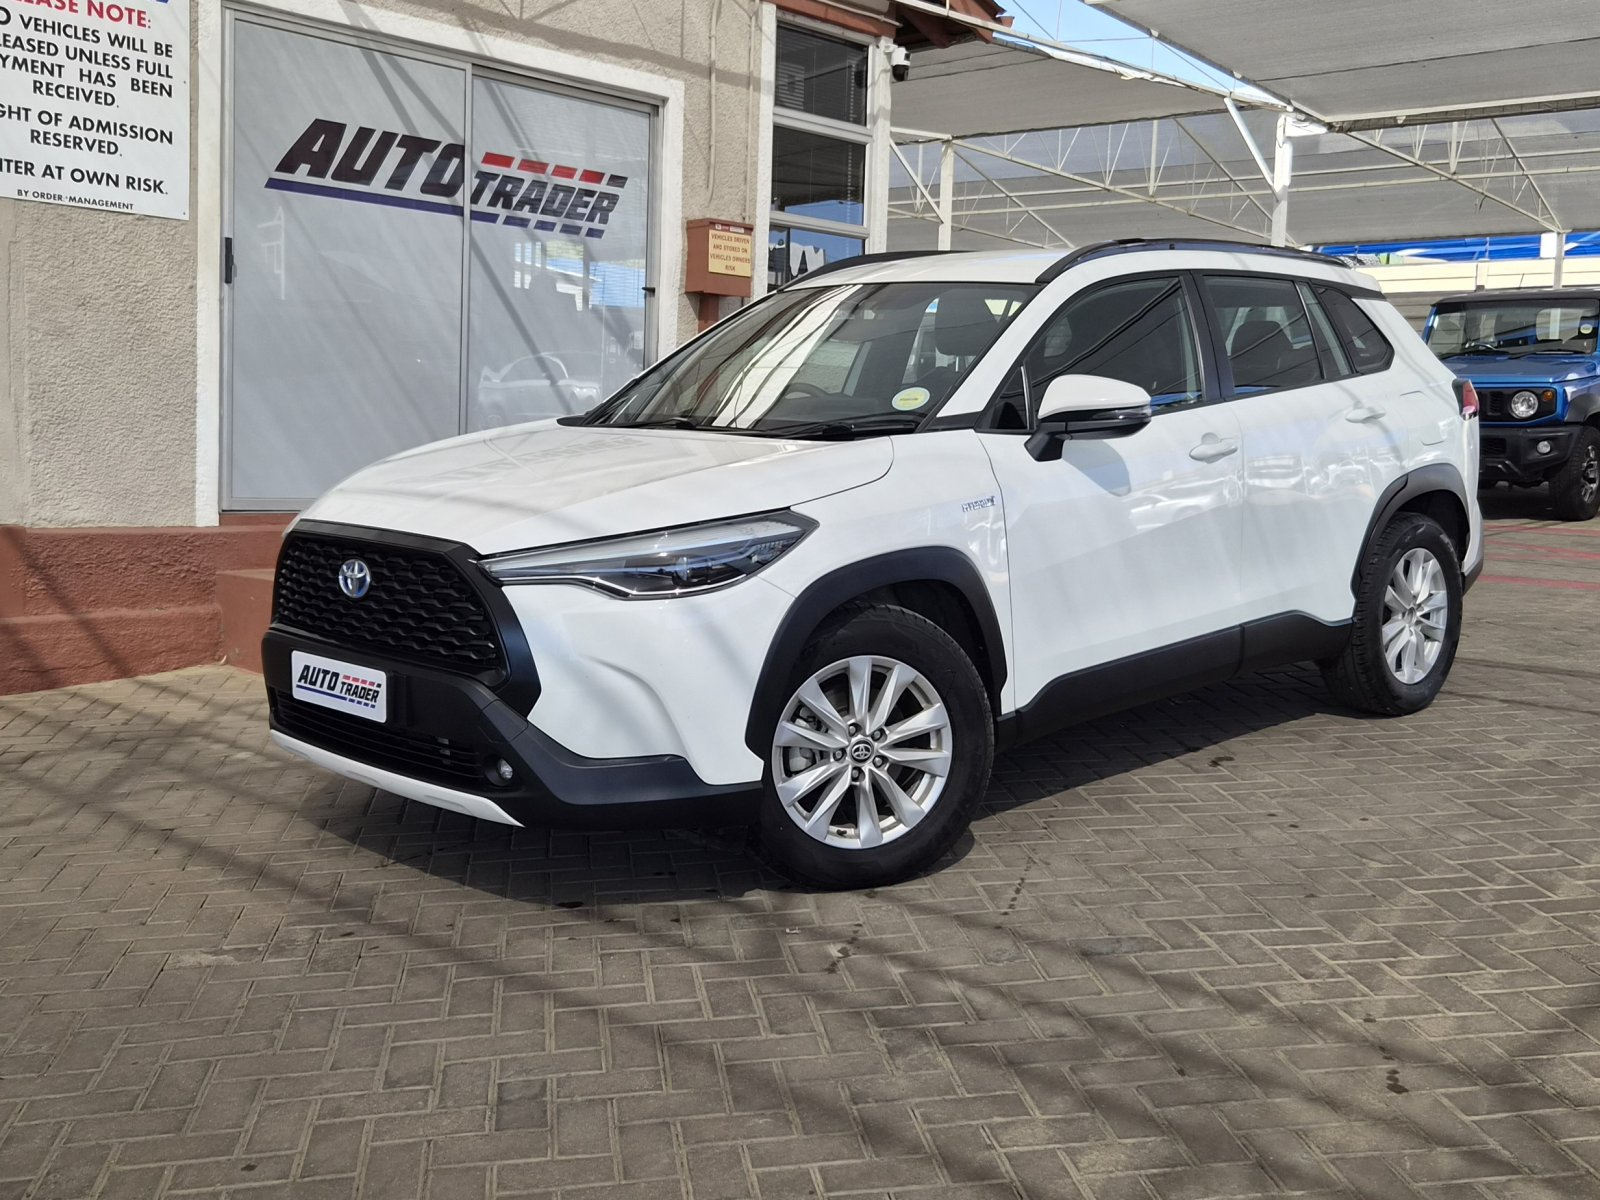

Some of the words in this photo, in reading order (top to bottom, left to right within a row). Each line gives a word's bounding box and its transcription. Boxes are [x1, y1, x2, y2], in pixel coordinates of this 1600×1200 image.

[87, 0, 151, 29] NOTE:
[19, 13, 101, 44] VEHICLES
[107, 32, 148, 54] WILL
[154, 41, 173, 58] BE
[0, 33, 59, 57] EASED
[65, 45, 131, 71] UNLESS
[136, 59, 173, 79] FULL
[32, 79, 119, 108] RECEIVED.
[79, 68, 117, 88] HAS
[130, 77, 173, 98] BEEN
[30, 129, 122, 157] RESERVED.
[37, 110, 63, 127] OF
[68, 115, 173, 145] ADMISSION
[0, 158, 36, 177] TER
[41, 164, 65, 180] AT
[70, 168, 119, 188] OWN
[126, 175, 168, 195] RISK.
[275, 118, 465, 198] AUTO
[470, 170, 620, 225] TRADER
[17, 189, 29, 197] BY
[298, 664, 340, 691] AUTO
[339, 681, 380, 703] TRADER
